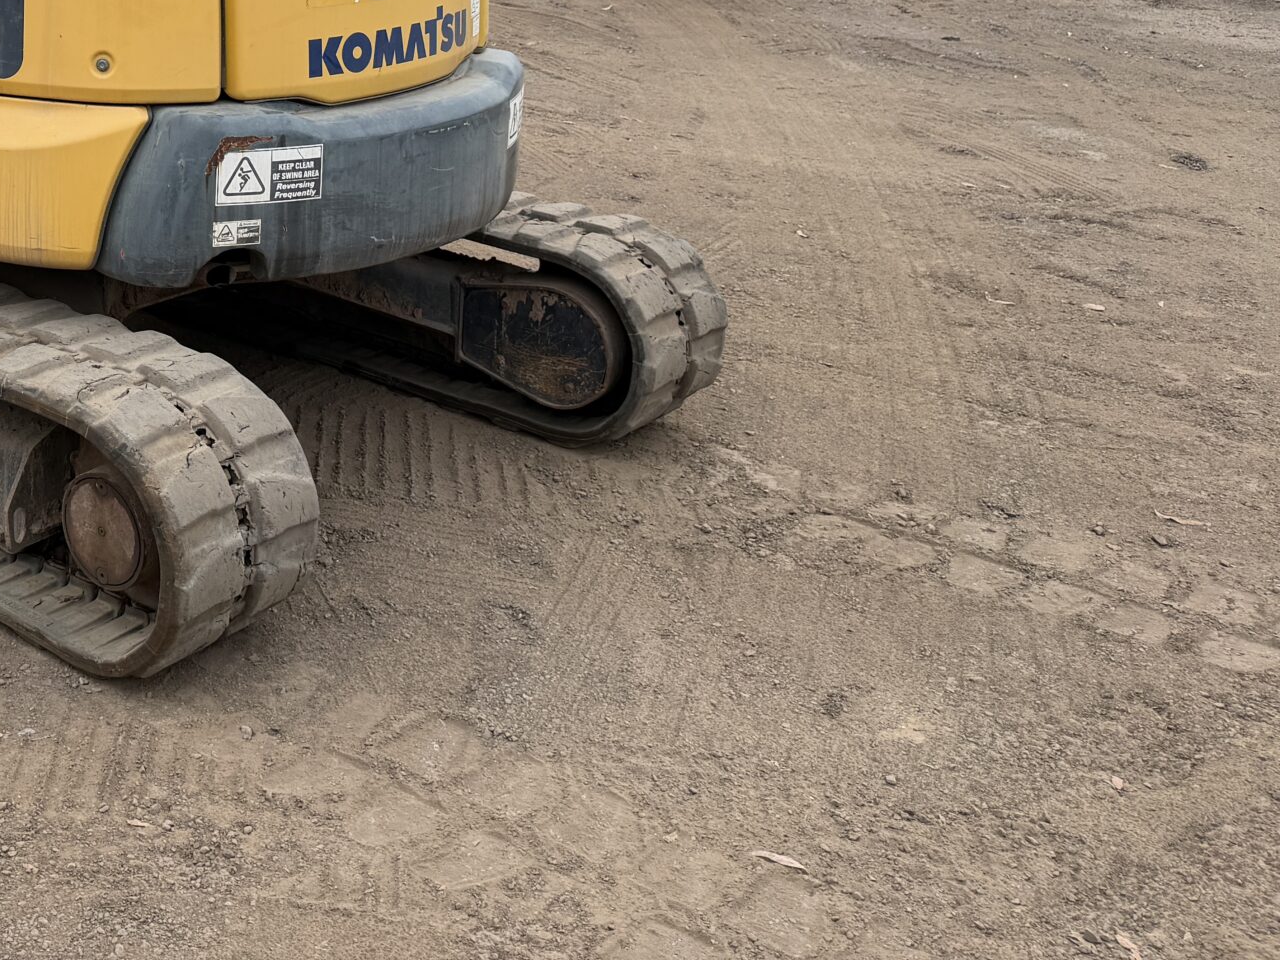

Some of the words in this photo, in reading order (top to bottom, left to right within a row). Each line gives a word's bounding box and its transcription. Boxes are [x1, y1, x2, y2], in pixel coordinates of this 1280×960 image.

[308, 5, 467, 79] KOMATSU
[278, 162, 294, 171] KEEP
[295, 161, 315, 170] CLEAR
[272, 172, 281, 180] OF
[281, 170, 302, 180] SWING
[303, 169, 320, 179] AREA
[276, 181, 315, 191] Reversing
[274, 188, 317, 199] Frequently
